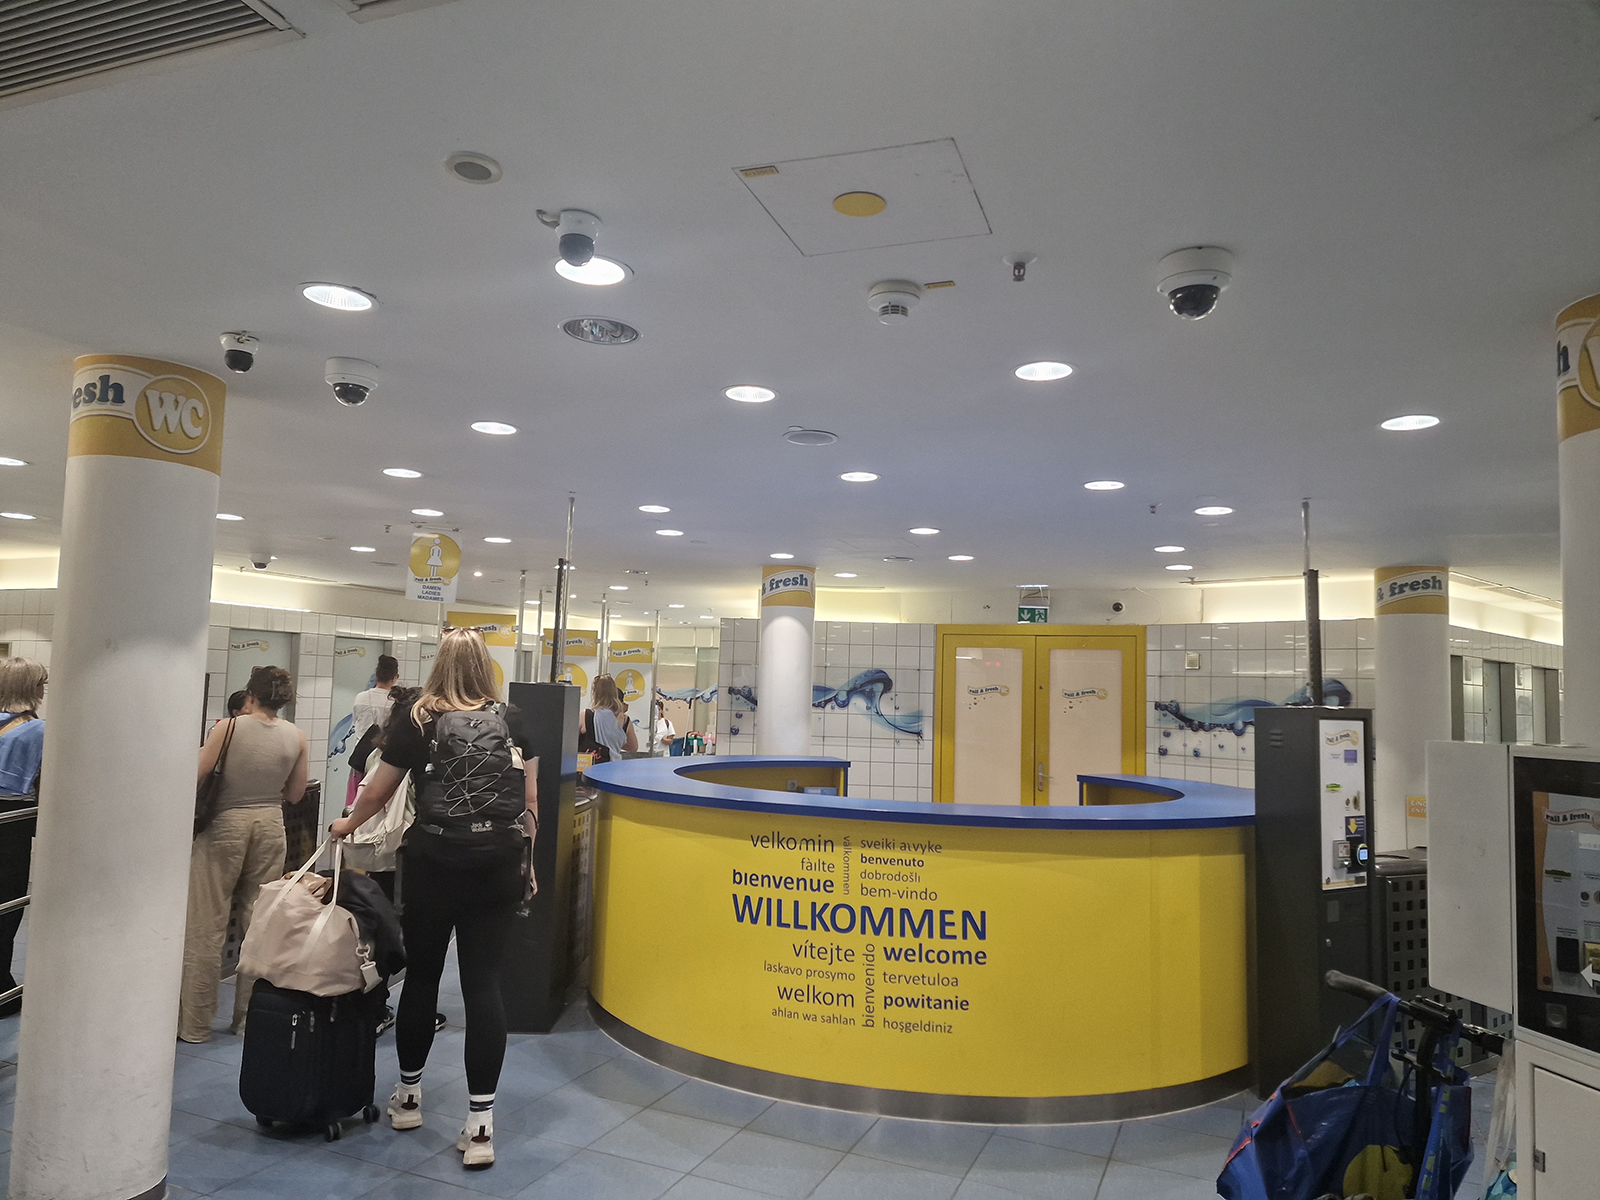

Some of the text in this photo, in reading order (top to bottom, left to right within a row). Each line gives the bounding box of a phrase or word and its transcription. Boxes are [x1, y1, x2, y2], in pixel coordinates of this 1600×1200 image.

[145, 389, 205, 440] WC
[769, 574, 808, 592] fresh
[1389, 575, 1443, 598] fresh
[1561, 814, 1568, 822] &
[750, 831, 835, 853] velkomin
[860, 838, 896, 851] sveiki
[843, 835, 852, 896] välkommen
[860, 853, 925, 868] benvenuto
[732, 868, 835, 894] bienvenue
[860, 883, 938, 902] bem-vindo
[732, 893, 987, 941] WILLKOMMEN
[792, 940, 856, 966] vítejte
[883, 942, 988, 966] welcome
[763, 960, 856, 983] laskavo prosymo
[883, 971, 960, 988] tervetuloa
[777, 984, 855, 1008] welkom
[862, 943, 876, 1028] bienvenido
[883, 993, 970, 1012] powitanie
[771, 1006, 856, 1026] ahlan wa sahlan
[883, 1017, 953, 1034] hoşgeldiniz
